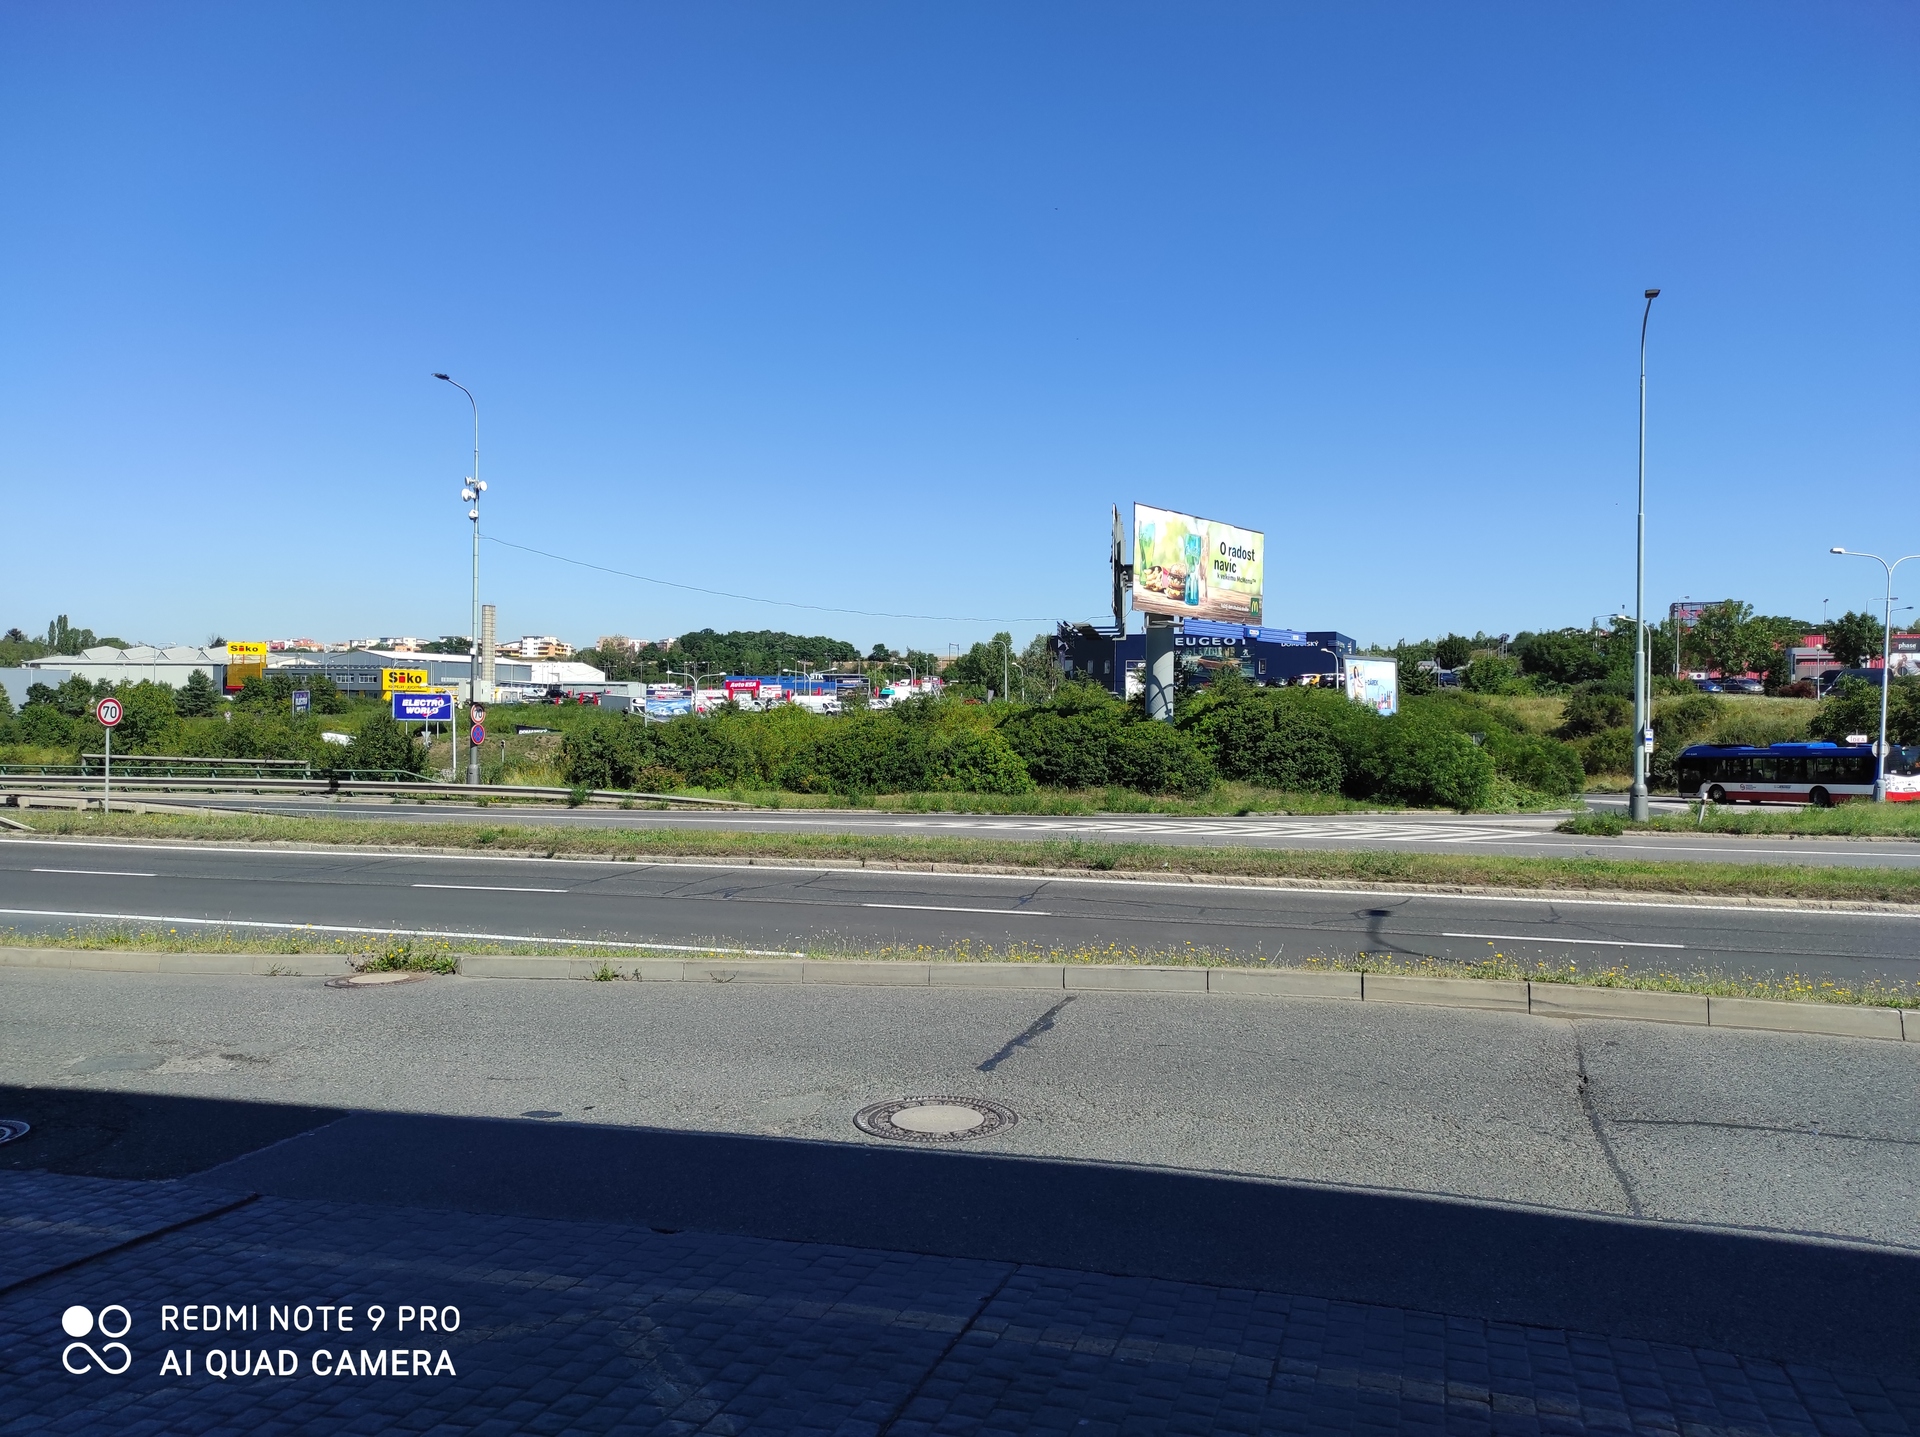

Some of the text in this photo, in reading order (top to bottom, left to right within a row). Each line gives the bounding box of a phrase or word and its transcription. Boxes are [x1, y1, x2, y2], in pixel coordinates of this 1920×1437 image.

[1220, 541, 1255, 561] O radost
[1214, 558, 1237, 573] navíc
[230, 644, 259, 652] Siko
[389, 671, 422, 684] Siko
[402, 698, 445, 707] ELECTRO
[102, 705, 118, 719] 70
[406, 706, 439, 715] WORLD
[474, 707, 482, 718] 70
